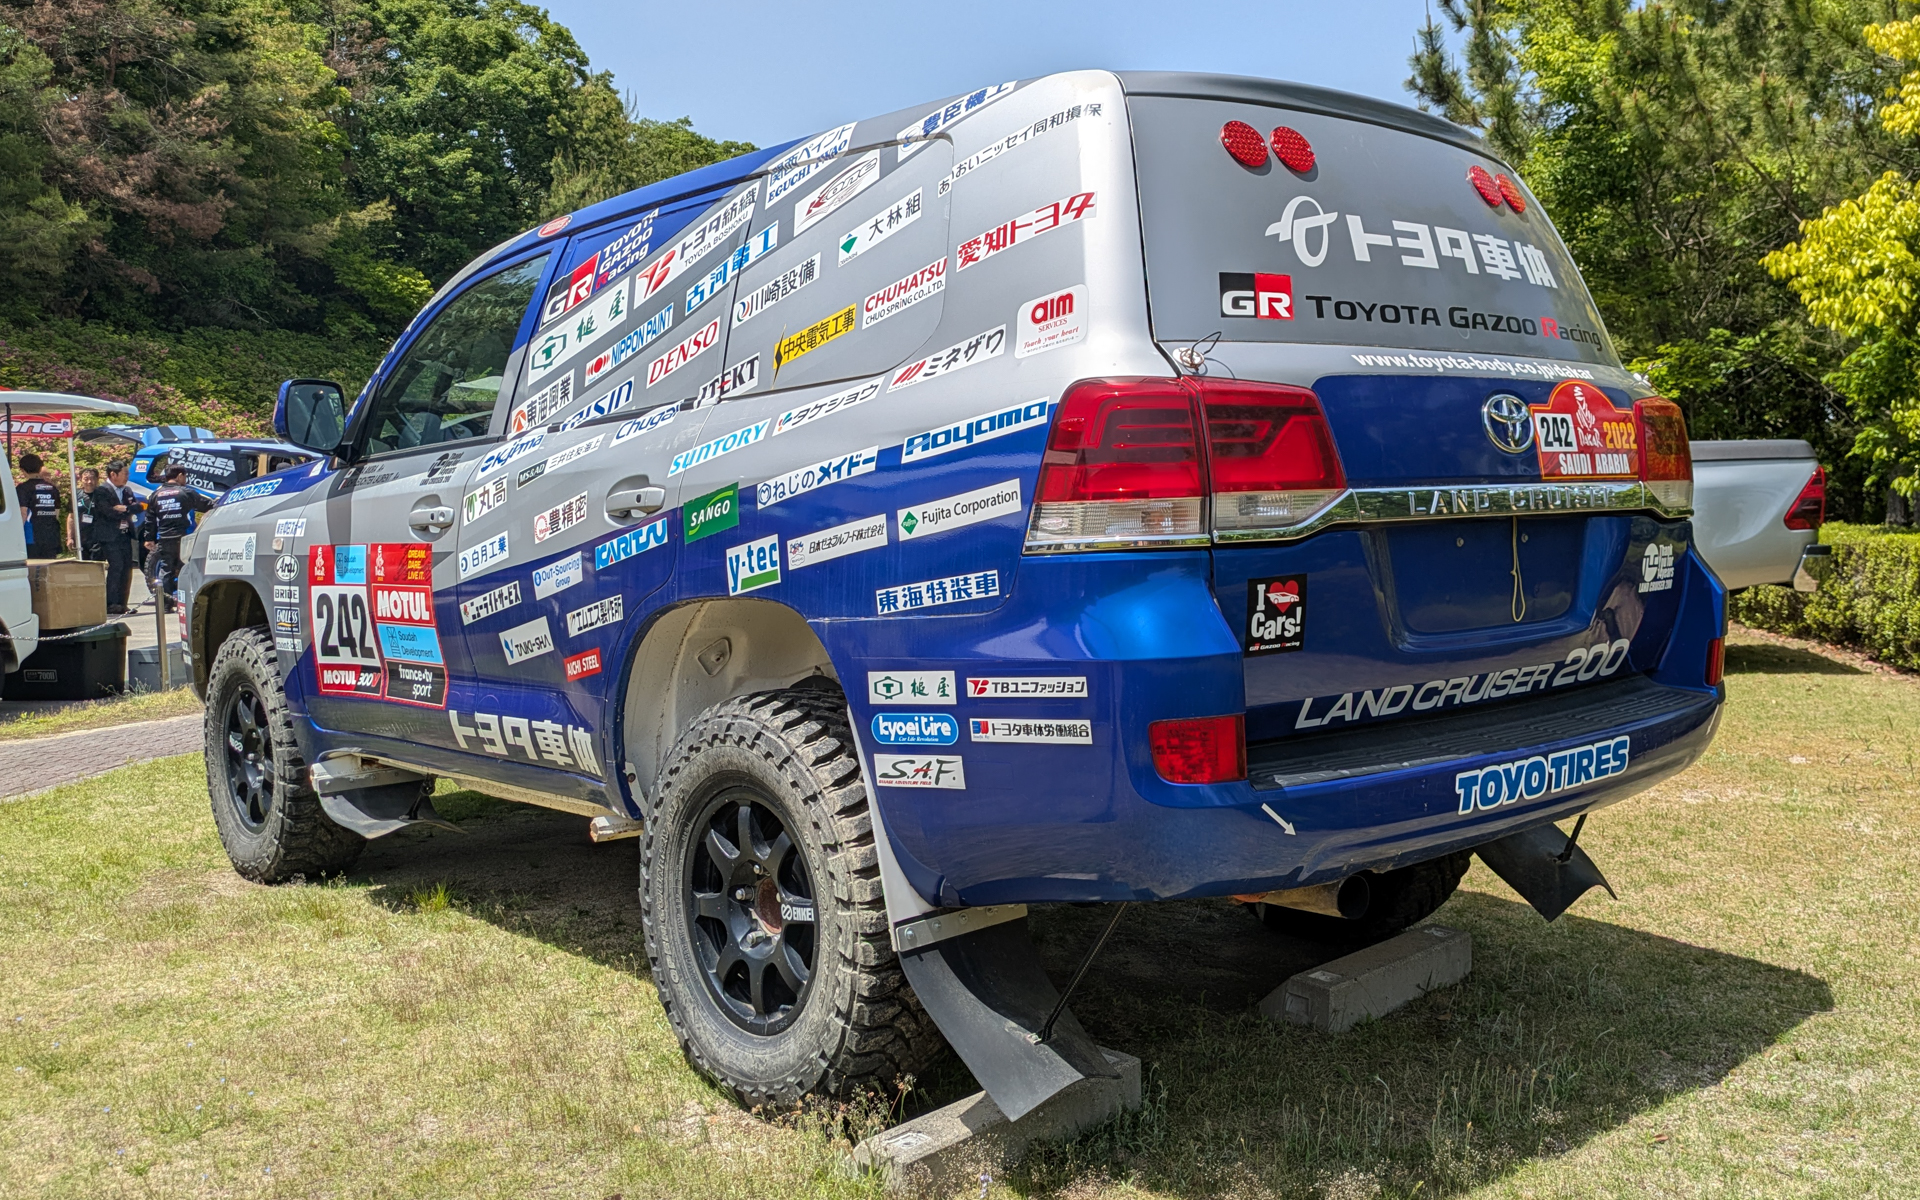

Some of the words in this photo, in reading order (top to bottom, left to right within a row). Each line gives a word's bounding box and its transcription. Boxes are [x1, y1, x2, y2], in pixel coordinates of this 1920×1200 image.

[768, 165, 811, 202] EGUCHI
[603, 208, 660, 258] TOYOTA
[680, 188, 757, 261] トヨタ紡織
[869, 191, 921, 242] 大林組
[957, 191, 1095, 270] 愛知トヨタ
[599, 226, 653, 275] GAZOO
[684, 243, 712, 267] TOYOTA
[713, 211, 749, 245] BOSHOKU
[1346, 213, 1559, 289] トヨタ車体
[595, 243, 649, 290] Racing
[687, 222, 778, 313] 古河電工
[543, 273, 593, 324] GR
[748, 258, 816, 317] 川崎設備
[865, 257, 948, 312] CHUHATSU
[865, 309, 886, 326] CHUO
[1031, 292, 1073, 324] aim
[1221, 288, 1292, 319] GR
[1305, 294, 1442, 327] TOYOTA
[1448, 306, 1538, 337] GAZOO
[1540, 316, 1602, 352] Racing
[611, 329, 645, 368] NIPPON
[645, 305, 674, 342] PAINT
[784, 307, 856, 361] 中央電気工事
[1023, 337, 1041, 349] Touch
[1061, 326, 1079, 337] heart
[1038, 318, 1068, 333] SERVICES
[649, 321, 718, 385] DENSO
[923, 328, 1005, 378] ミネザワ
[1352, 352, 1595, 380] www.toyota-body.co.jp/dakar
[905, 400, 1048, 456] Aoyama
[1540, 416, 1574, 447] 242
[1603, 421, 1638, 450] 2022
[519, 463, 546, 483] MS&AD
[1558, 453, 1592, 475] SAUDI
[1595, 453, 1631, 475] ARABIA
[479, 476, 507, 516] 丸高
[922, 505, 952, 525] Fujita
[953, 489, 1019, 518] Corporation
[1409, 489, 1491, 515] LAND
[690, 500, 731, 527] SANGO
[407, 550, 426, 558] DREAM.
[471, 535, 507, 568] 白月工業
[728, 542, 778, 593] y-tec
[274, 588, 298, 599] BRIDE
[555, 576, 571, 588] Group
[878, 572, 999, 613] 東海特装車
[1256, 583, 1266, 611] I
[276, 609, 298, 623] ENDLESS
[377, 590, 430, 621] MOTUL
[470, 583, 521, 620] ニューライトサービス
[316, 592, 376, 660] 242
[399, 628, 418, 642] Soudah
[1251, 606, 1303, 640] Cars!
[402, 643, 434, 659] Development
[515, 634, 551, 657] TAIKI-SHA
[324, 670, 357, 686] MOTUL
[357, 672, 381, 688] 300V
[567, 662, 582, 676] AICHI
[582, 654, 600, 672] STEEL
[412, 683, 432, 700] sport
[991, 681, 1085, 694] TBユニファッション
[1295, 685, 1415, 729] LAND
[1412, 663, 1556, 711] CRUISER
[1552, 638, 1631, 688] 200
[449, 710, 603, 777] トヨタ車体
[879, 715, 920, 741] kyoei
[920, 716, 952, 736] tire
[991, 723, 1090, 738] トヨタ車体労働組合
[878, 758, 959, 786] S.A.F.
[1456, 755, 1549, 815] TOYO
[1548, 736, 1630, 793] TIRES
[792, 906, 815, 922] ENKEI
